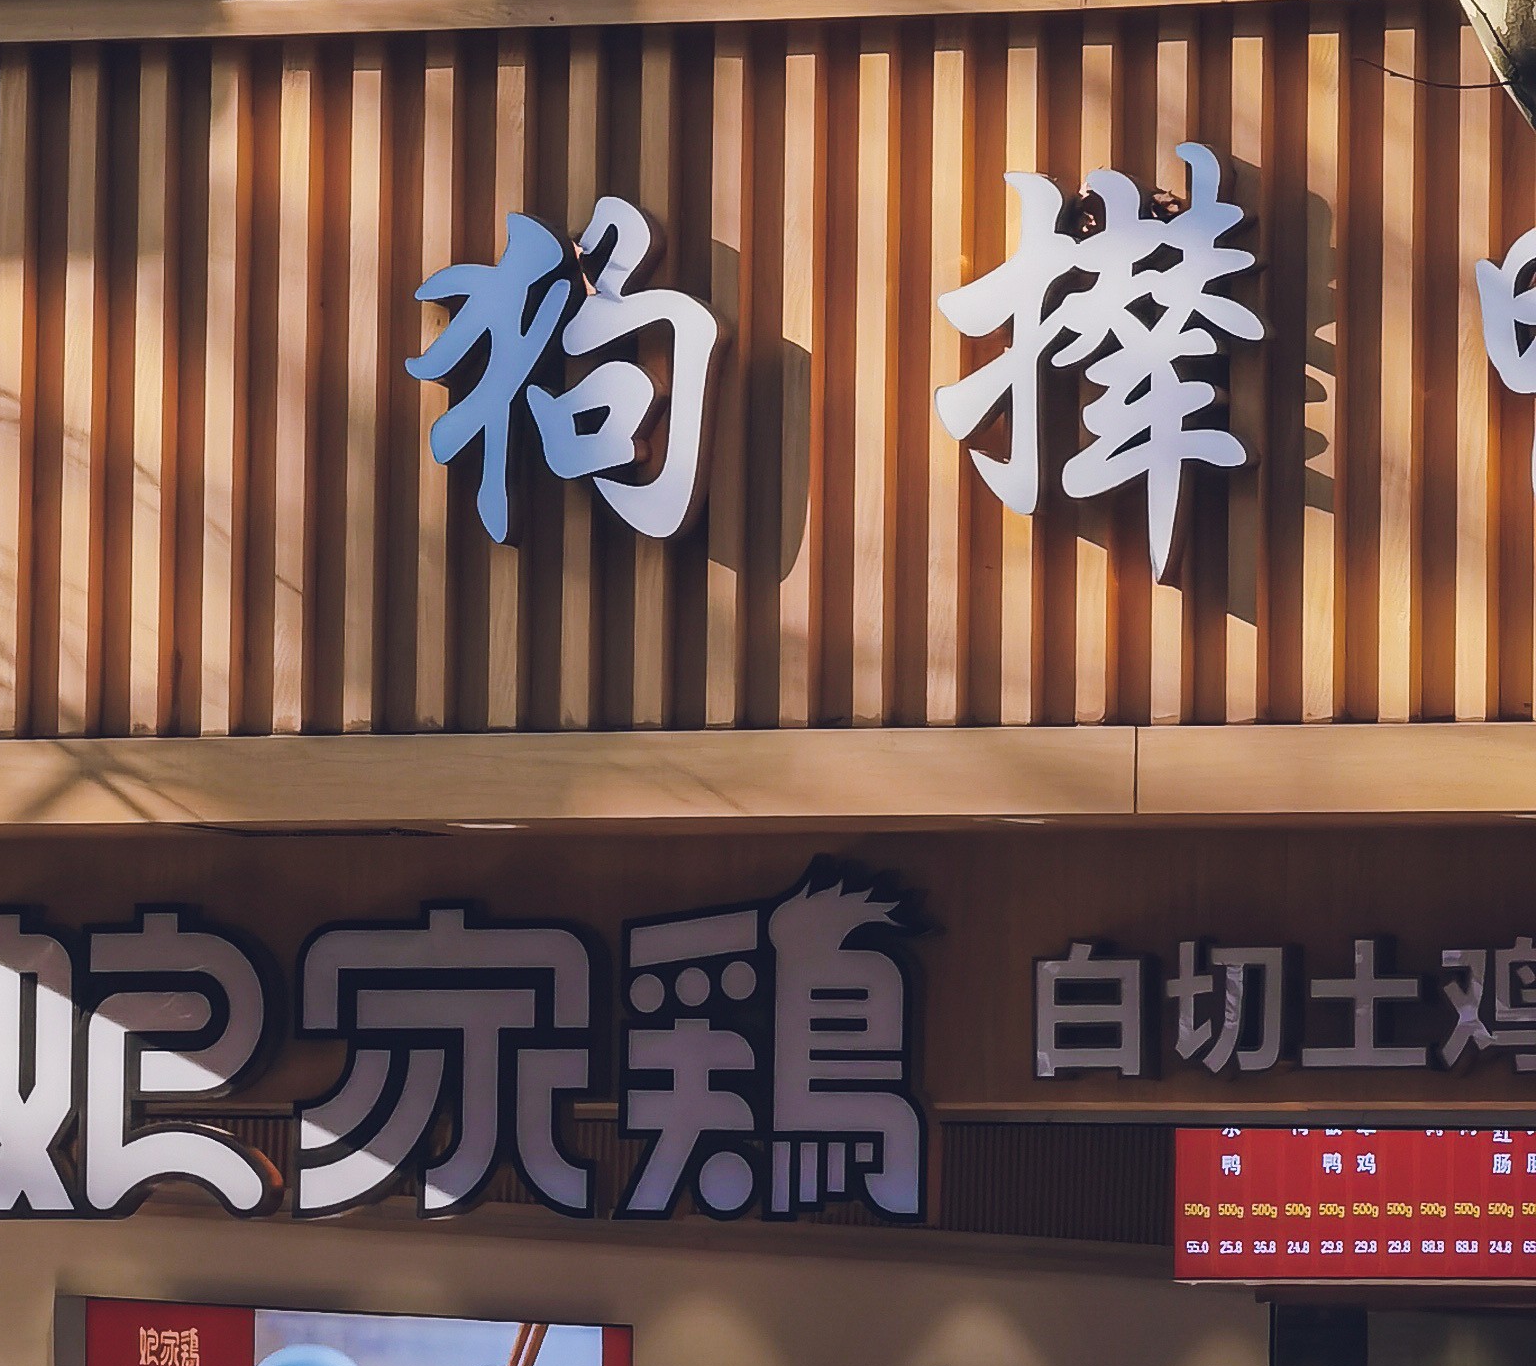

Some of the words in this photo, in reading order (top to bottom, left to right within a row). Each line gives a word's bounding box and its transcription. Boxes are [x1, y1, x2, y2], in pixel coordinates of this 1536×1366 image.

[1036, 936, 1536, 1077] 白切土鸡
[1184, 1203, 1210, 1219] 500g
[1218, 1203, 1243, 1219] 500g
[1252, 1203, 1277, 1219] 500g
[1285, 1203, 1311, 1219] 500g
[1319, 1203, 1345, 1219] 500g
[1353, 1203, 1378, 1219] 500g
[1387, 1203, 1412, 1219] 500g
[1420, 1203, 1446, 1219] 500g
[1454, 1203, 1480, 1219] 500g
[1488, 1203, 1513, 1219] 500g
